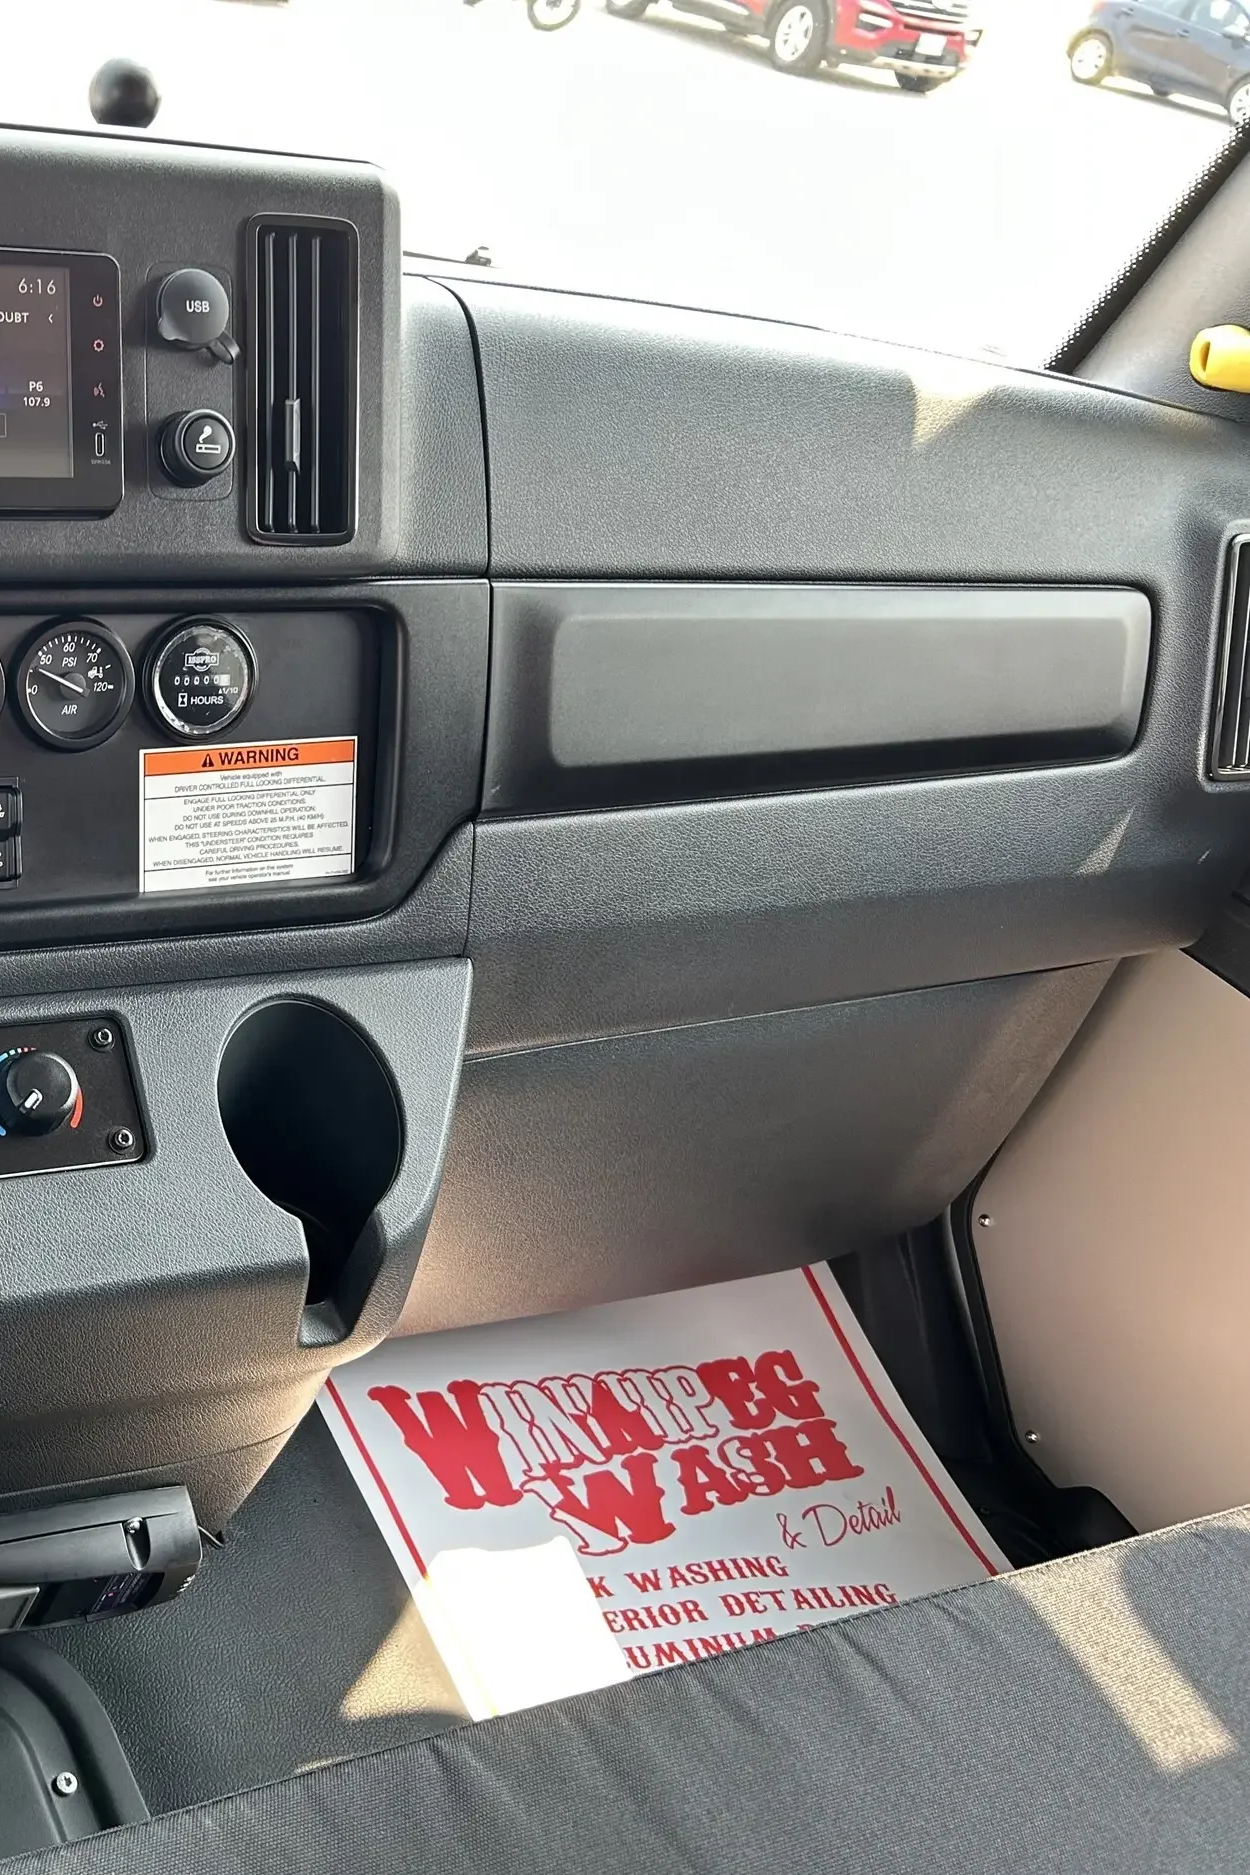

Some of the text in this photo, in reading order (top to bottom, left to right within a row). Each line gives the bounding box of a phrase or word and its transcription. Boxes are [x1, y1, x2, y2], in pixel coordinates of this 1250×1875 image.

[18, 278, 56, 294] 6:16
[186, 300, 210, 313] USB
[29, 381, 43, 392] P6
[23, 397, 51, 407] 107.9
[63, 642, 75, 652] 60
[40, 655, 52, 664] 50
[62, 657, 77, 667] PSI
[86, 653, 98, 663] 70
[31, 685, 37, 694] 0
[93, 682, 107, 691] 120
[191, 696, 224, 704] HOURS
[61, 705, 77, 715] AIR
[219, 748, 299, 766] WARNING
[243, 772, 269, 780] equipped
[175, 785, 197, 793] DRIVER
[199, 782, 239, 791] CONTROLLED
[256, 779, 282, 787] LOCKING
[184, 797, 210, 805] ENGAGE
[228, 794, 255, 802] LOCKING
[257, 790, 298, 799] DIFFERENTIAL
[236, 801, 266, 809] TRACTION
[248, 809, 278, 817] DOWNHILL
[222, 819, 247, 827] SPEEDS
[202, 831, 233, 839] STEERING
[234, 826, 290, 837] CHARACTERISTICS
[368, 1349, 826, 1509] WINNIPEG
[521, 1418, 864, 1556] WASH
[776, 1485, 901, 1550] & Detail
[625, 1555, 790, 1593] WASHING
[602, 1583, 897, 1634] ERIOR DETAILING
